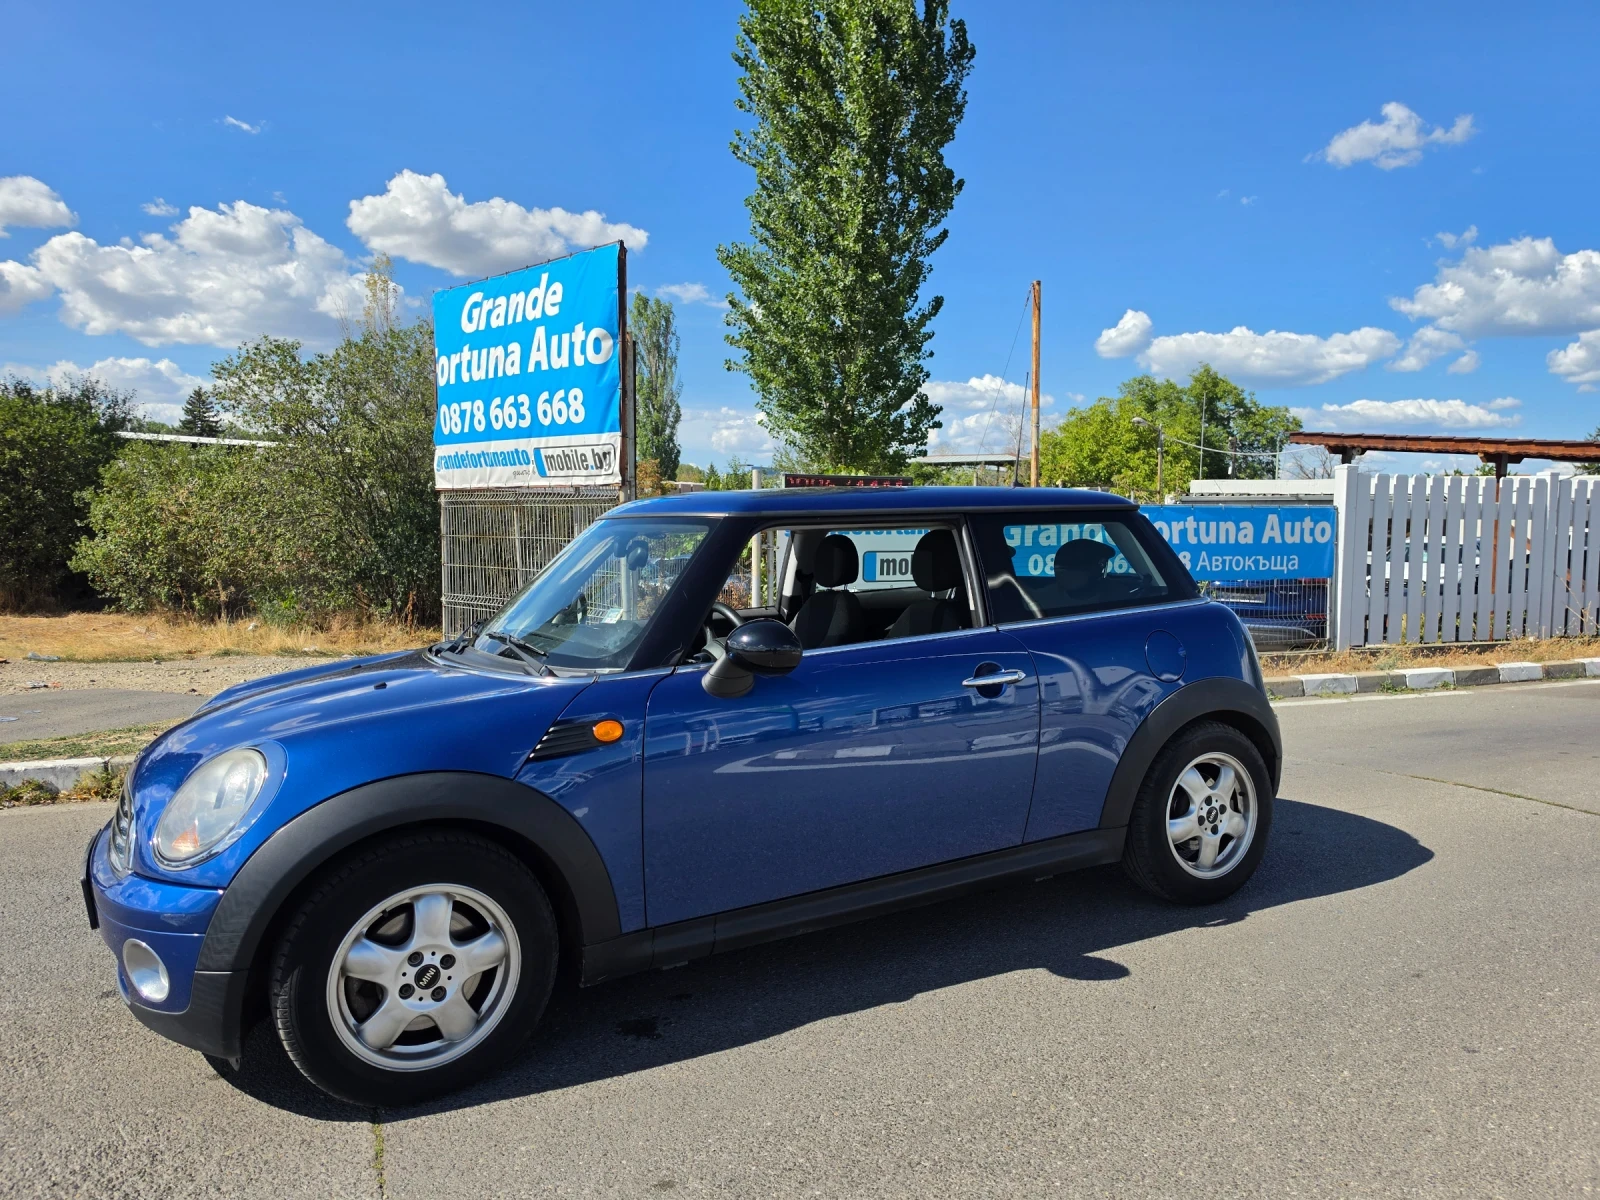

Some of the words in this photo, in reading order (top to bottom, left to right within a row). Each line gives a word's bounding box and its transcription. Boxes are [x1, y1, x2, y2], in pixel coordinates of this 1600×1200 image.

[460, 272, 564, 334] Grande
[527, 321, 614, 373] Auto
[440, 399, 486, 435] 0878
[490, 394, 531, 431] 663
[537, 387, 586, 426] 668
[544, 448, 612, 472] mobile.bg
[1144, 513, 1254, 545] ortuna
[1261, 513, 1332, 544] Auto
[1195, 550, 1299, 574] Автокъща
[419, 967, 437, 987] MINI
